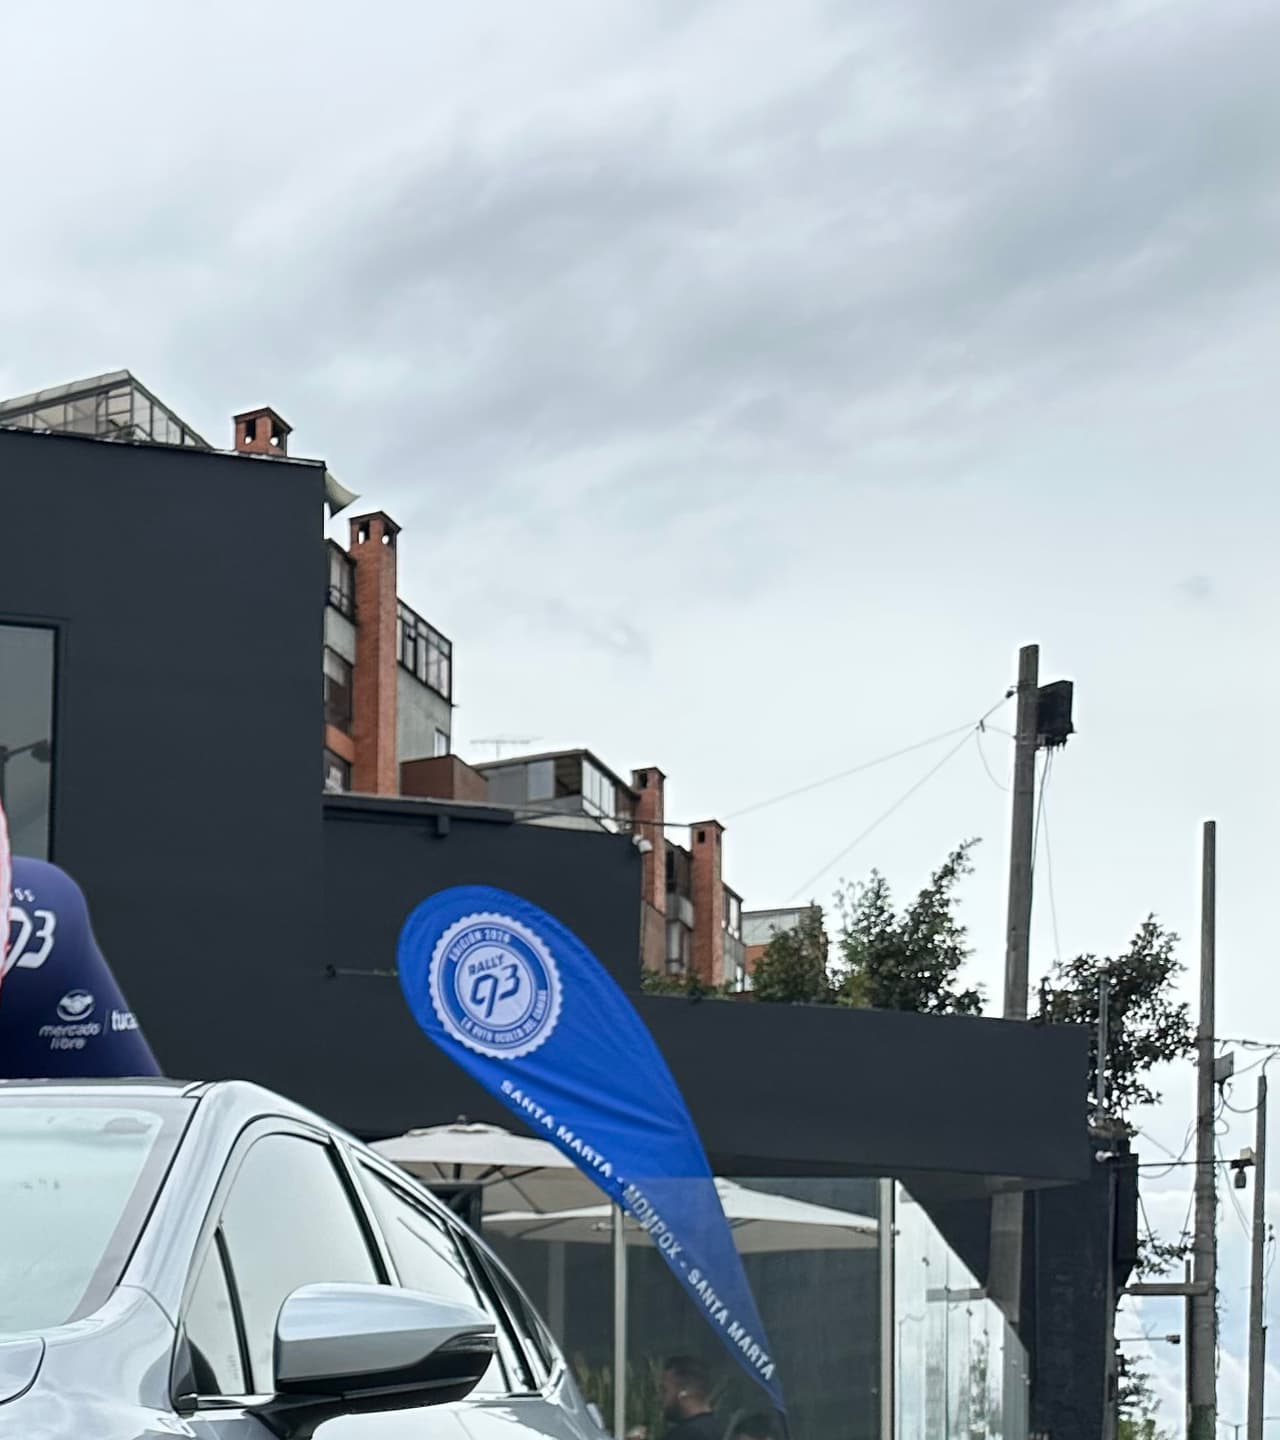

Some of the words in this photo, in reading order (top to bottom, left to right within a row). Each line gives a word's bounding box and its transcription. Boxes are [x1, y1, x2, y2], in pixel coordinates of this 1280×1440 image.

[468, 954, 504, 976] RALLY
[470, 963, 521, 1019] 93
[38, 1022, 103, 1038] mercado
[500, 1080, 554, 1129] SANTA
[556, 1125, 613, 1177] MARTA
[622, 1184, 682, 1260] MOMPOX
[687, 1268, 729, 1326] SANTA
[727, 1321, 777, 1381] MARTA
